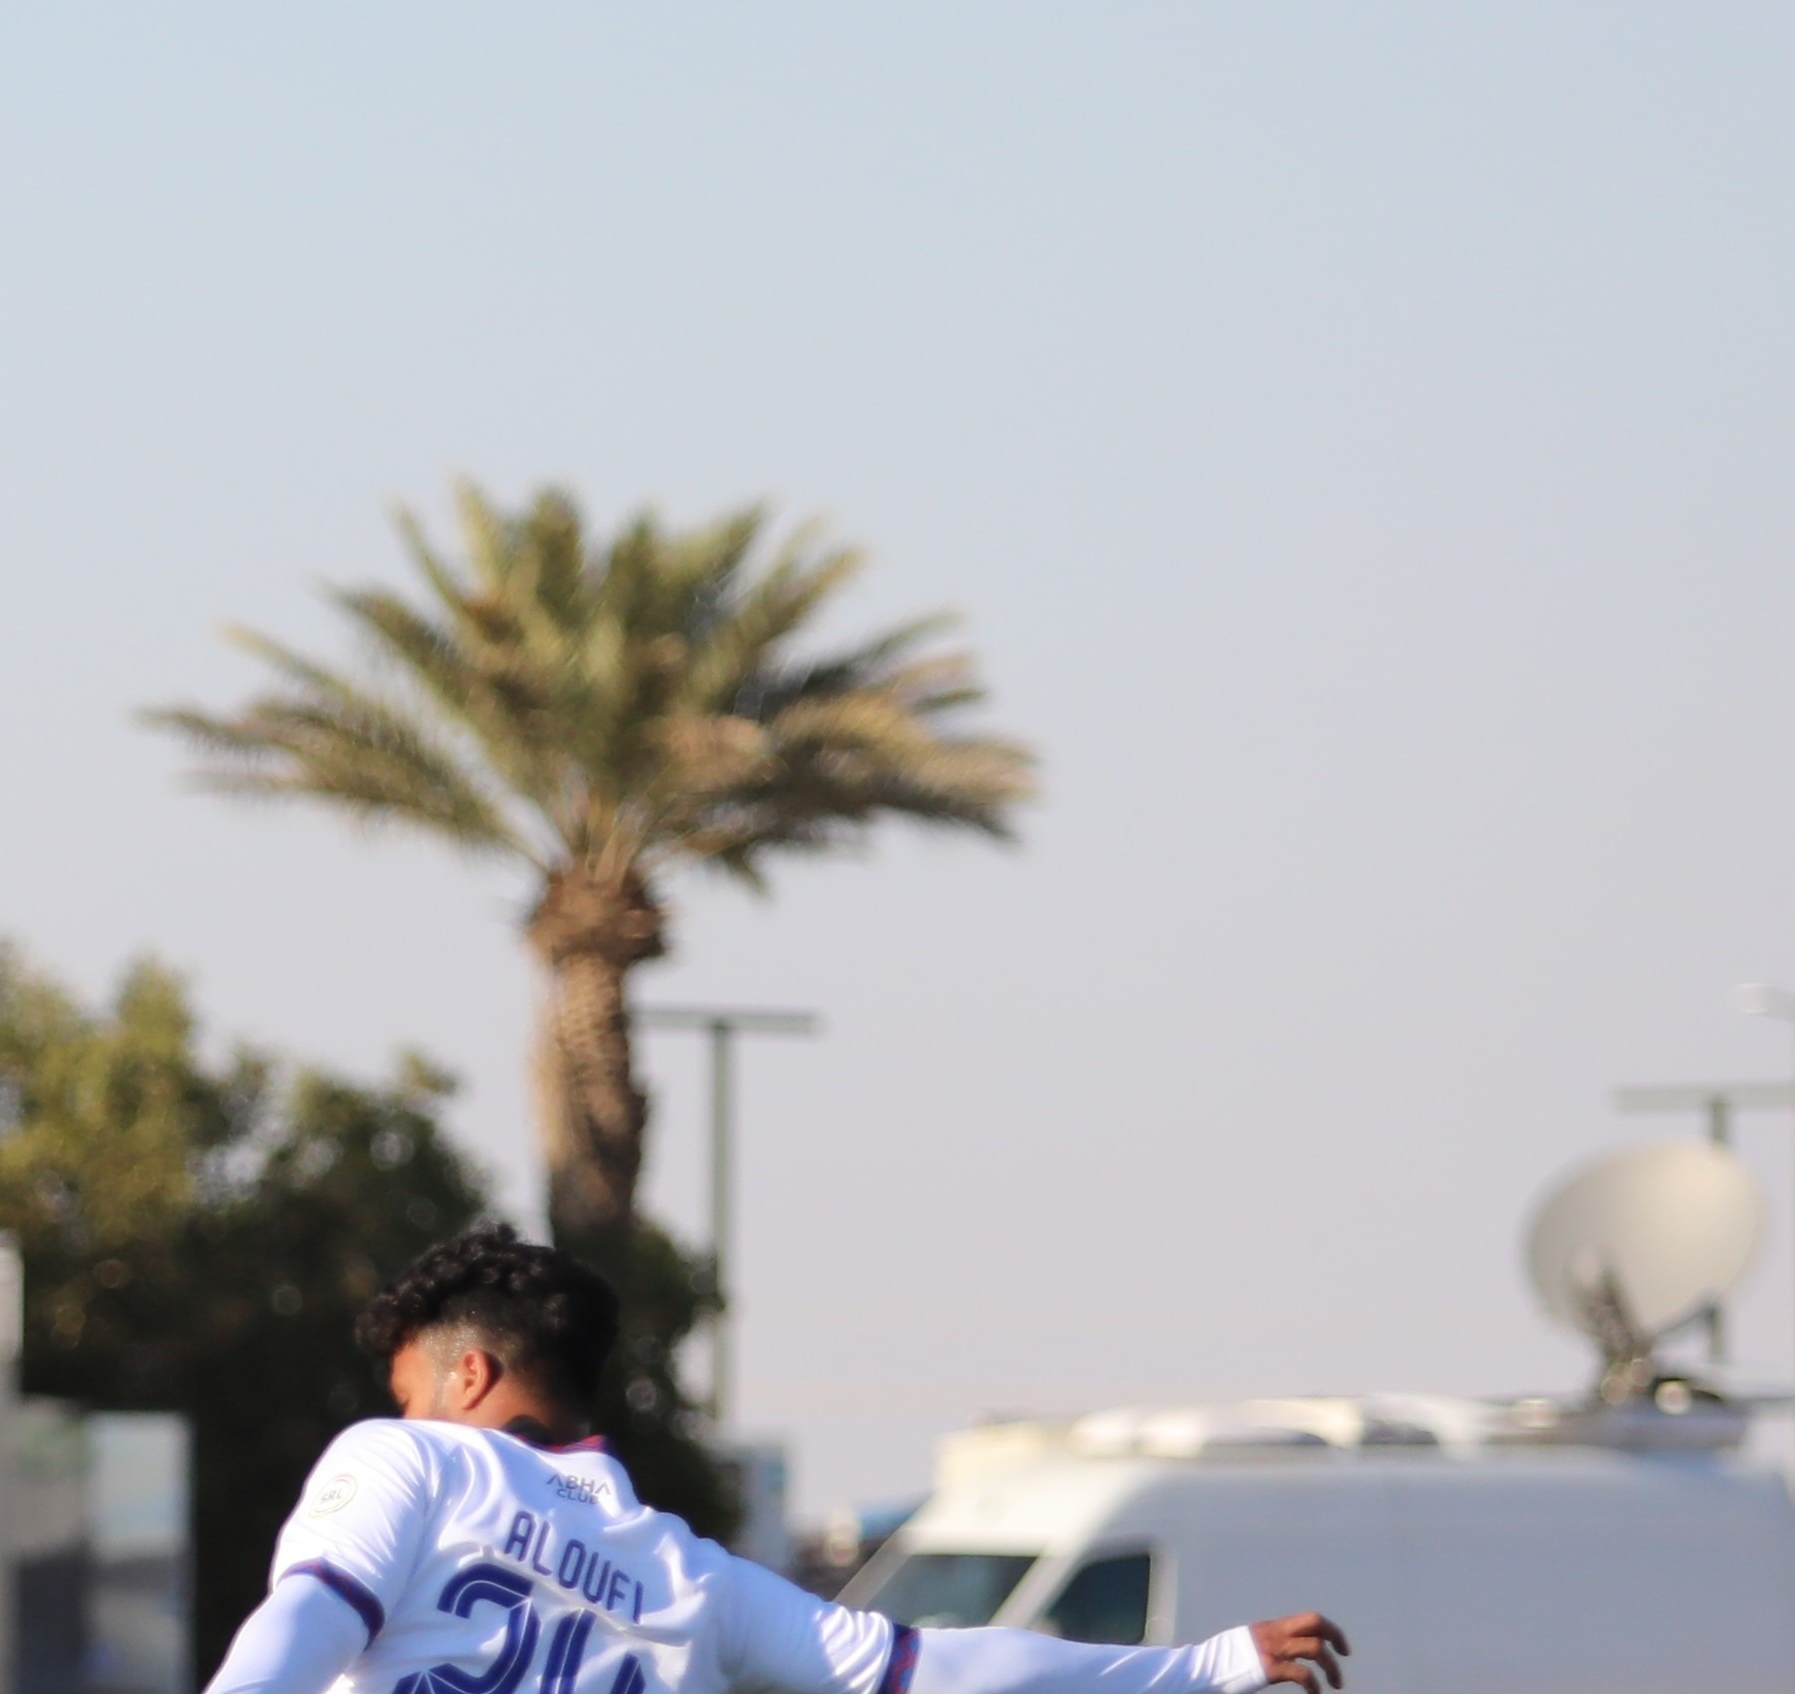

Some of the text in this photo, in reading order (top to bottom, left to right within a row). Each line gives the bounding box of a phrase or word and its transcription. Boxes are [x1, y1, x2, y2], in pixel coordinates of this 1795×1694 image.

[546, 1473, 611, 1496] ABHA
[557, 1488, 599, 1505] CLUB
[505, 1510, 643, 1625] ALOUFI
